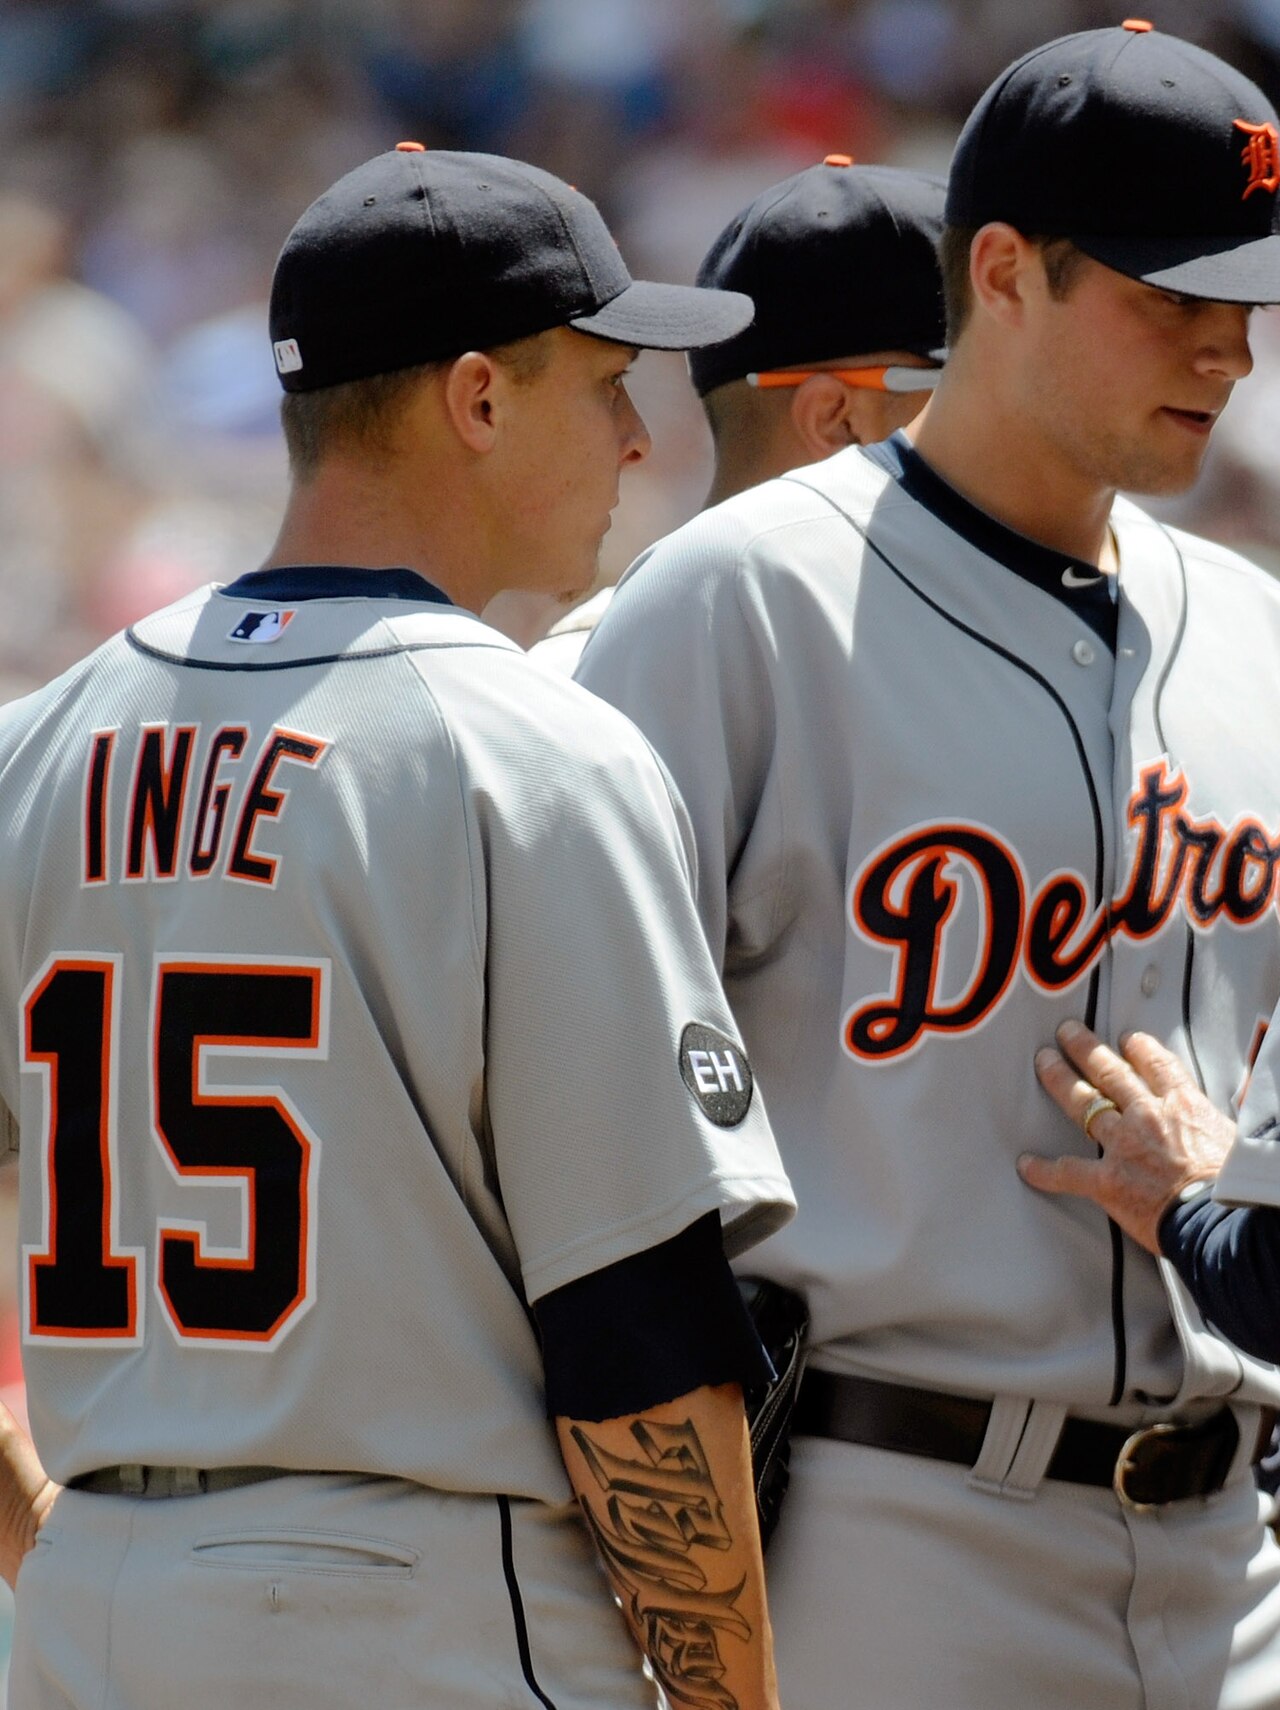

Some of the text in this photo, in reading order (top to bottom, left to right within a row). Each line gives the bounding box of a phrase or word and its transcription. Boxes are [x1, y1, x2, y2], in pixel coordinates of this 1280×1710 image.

[82, 723, 332, 888] INGE
[21, 953, 331, 1352] 15
[688, 1049, 744, 1093] EH
